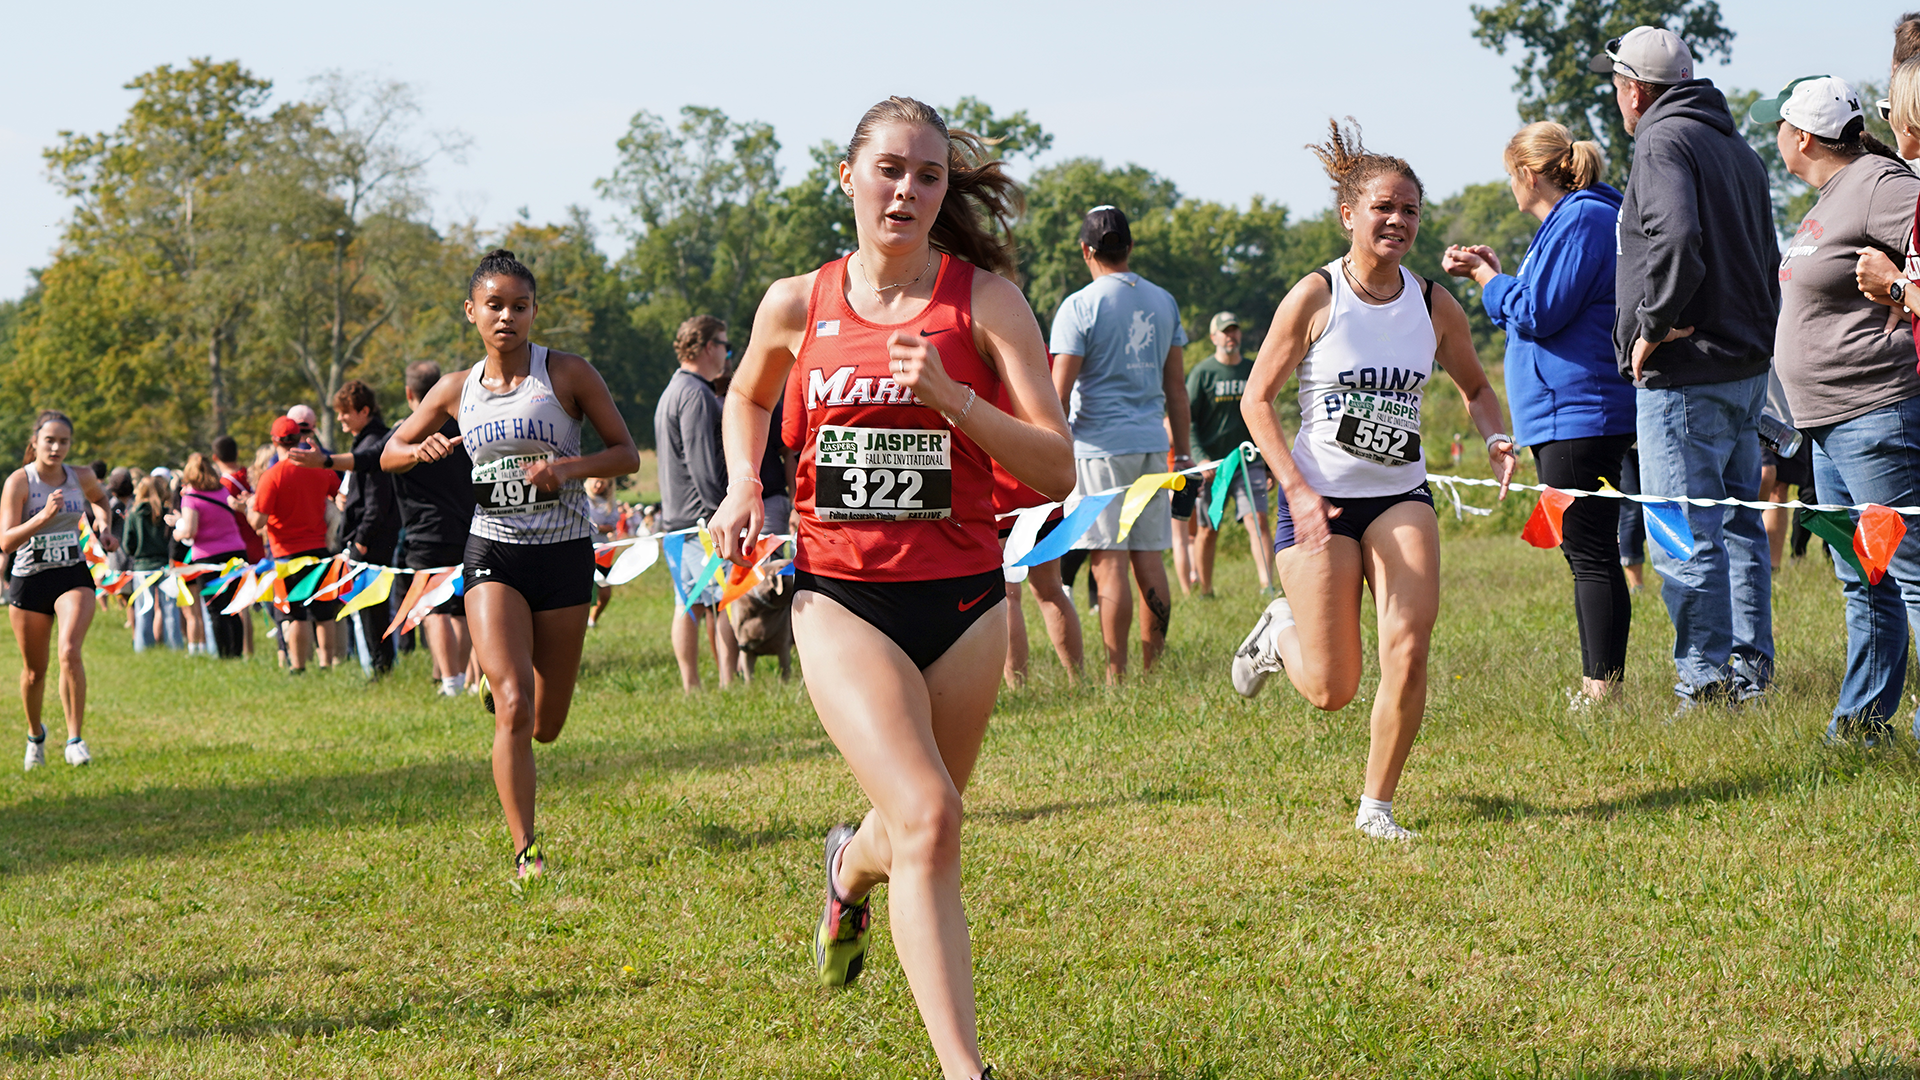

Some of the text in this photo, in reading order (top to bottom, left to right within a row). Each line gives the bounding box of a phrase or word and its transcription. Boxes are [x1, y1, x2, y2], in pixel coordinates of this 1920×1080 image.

[1848, 98, 1860, 112] M
[1338, 367, 1425, 391] SAINT
[512, 418, 557, 446] HALL
[1353, 419, 1409, 458] 552
[822, 442, 856, 452] JASPERS
[864, 433, 943, 452] JASPER
[865, 453, 944, 466] FALL XC INVITATIONAL
[490, 480, 537, 506] 497
[841, 468, 923, 508] 322
[49, 533, 74, 541] JASPER
[42, 546, 70, 563] 491
